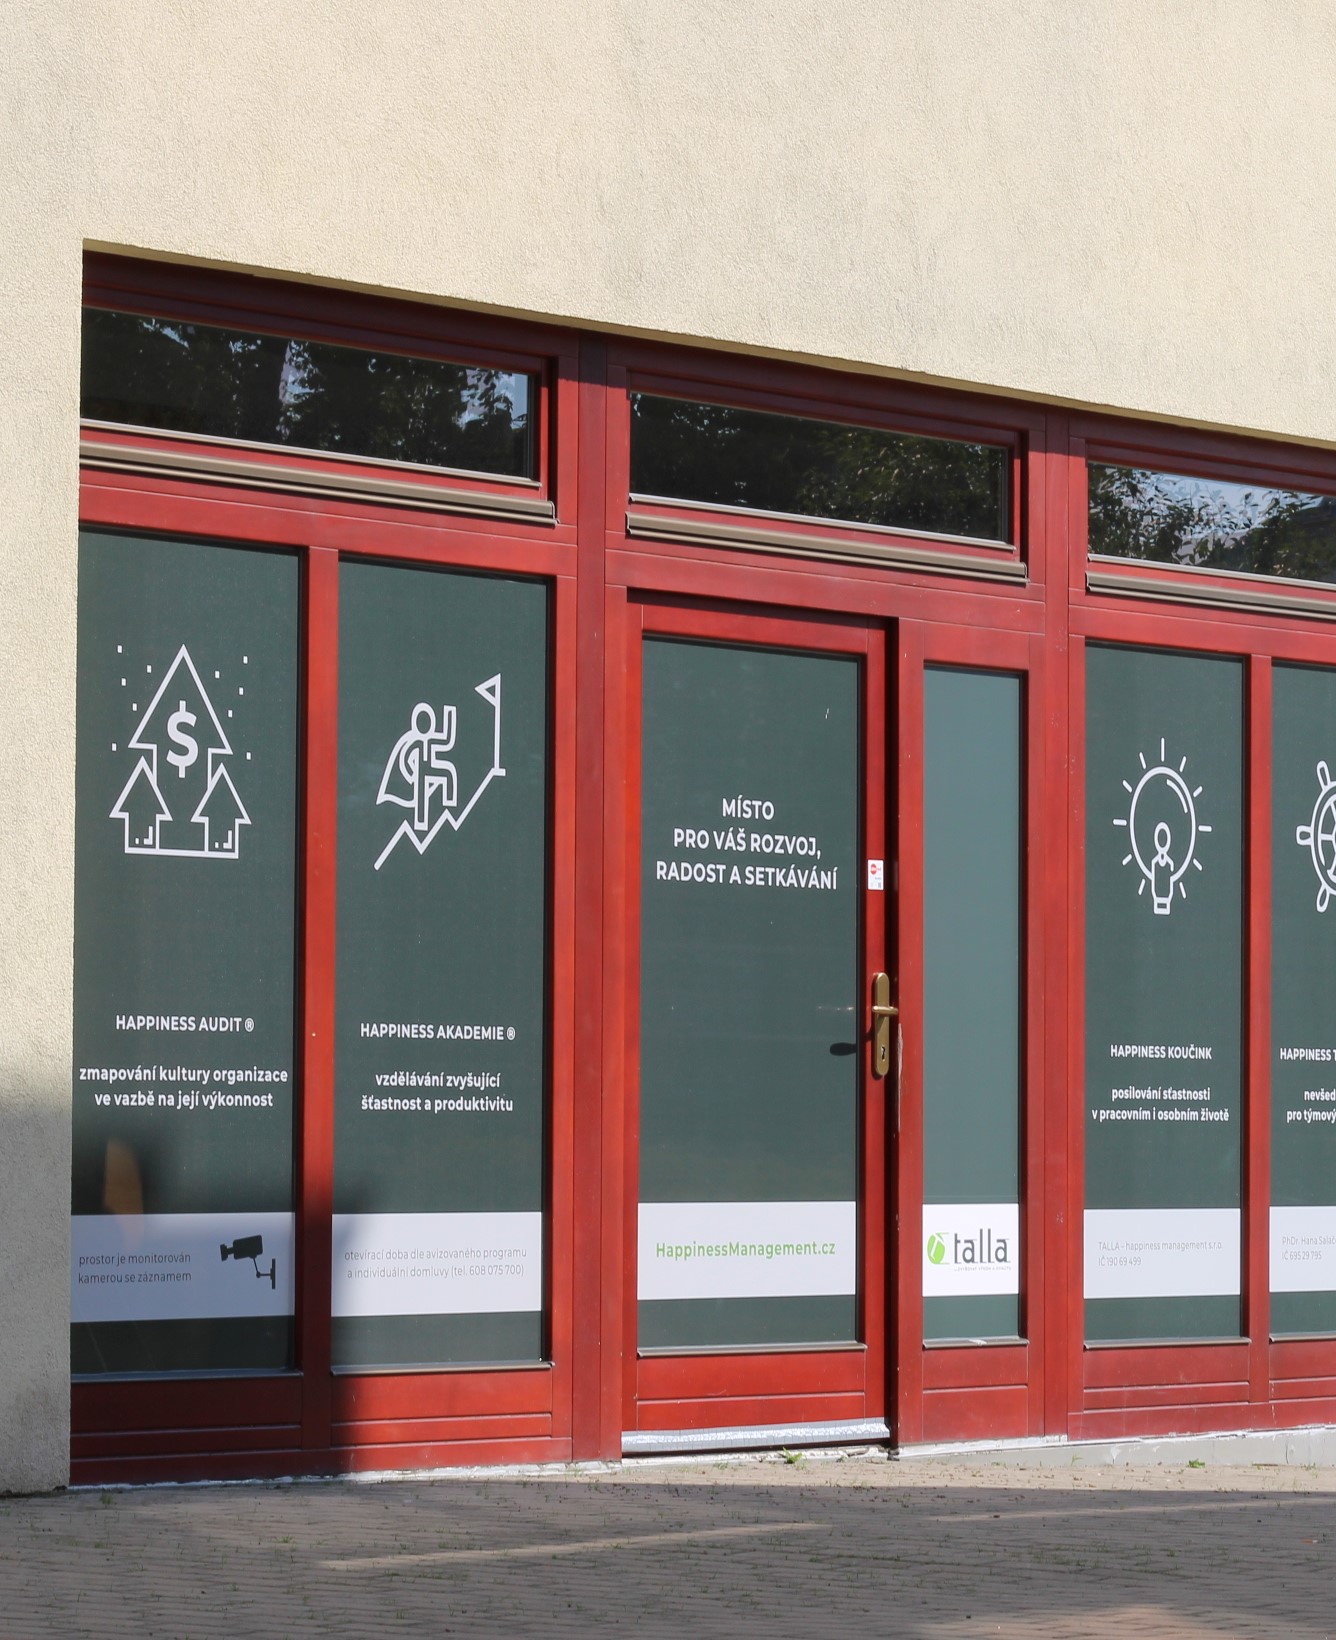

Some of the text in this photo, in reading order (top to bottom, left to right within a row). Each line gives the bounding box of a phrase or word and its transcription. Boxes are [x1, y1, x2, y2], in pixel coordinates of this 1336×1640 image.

[722, 794, 775, 820] MÍSTO
[673, 827, 822, 859] PRO VÁŠ ROZVOJ,
[656, 860, 838, 890] RADOST A SETKÁVÁNÍ
[116, 1015, 196, 1031] HAPPINESS
[199, 1017, 242, 1032] AUDIT
[360, 1022, 435, 1039] HAPPINESS
[436, 1025, 505, 1041] AKADEMIE
[1110, 1044, 1212, 1060] HAPPINESS KOUČINK
[1280, 1047, 1332, 1061] HAPPINESS
[79, 1065, 289, 1085] zmapování kultury organizace
[375, 1071, 501, 1091] vzdělávání zvyšující
[94, 1090, 274, 1110] ve vazbě na její výkonnost
[1112, 1086, 1162, 1102] posilování
[361, 1094, 514, 1114] šťastnost a produktivitu
[1091, 1107, 1229, 1122] v pracovním i osobním životě
[1286, 1110, 1302, 1123] pro
[1303, 1108, 1336, 1123] týmový
[655, 1240, 836, 1260] HappinessManagement.cz
[954, 1228, 1011, 1264] talla
[79, 1251, 191, 1268] prostor je monitorován
[78, 1271, 192, 1284] kamerou se záznamem
[347, 1269, 353, 1278] a
